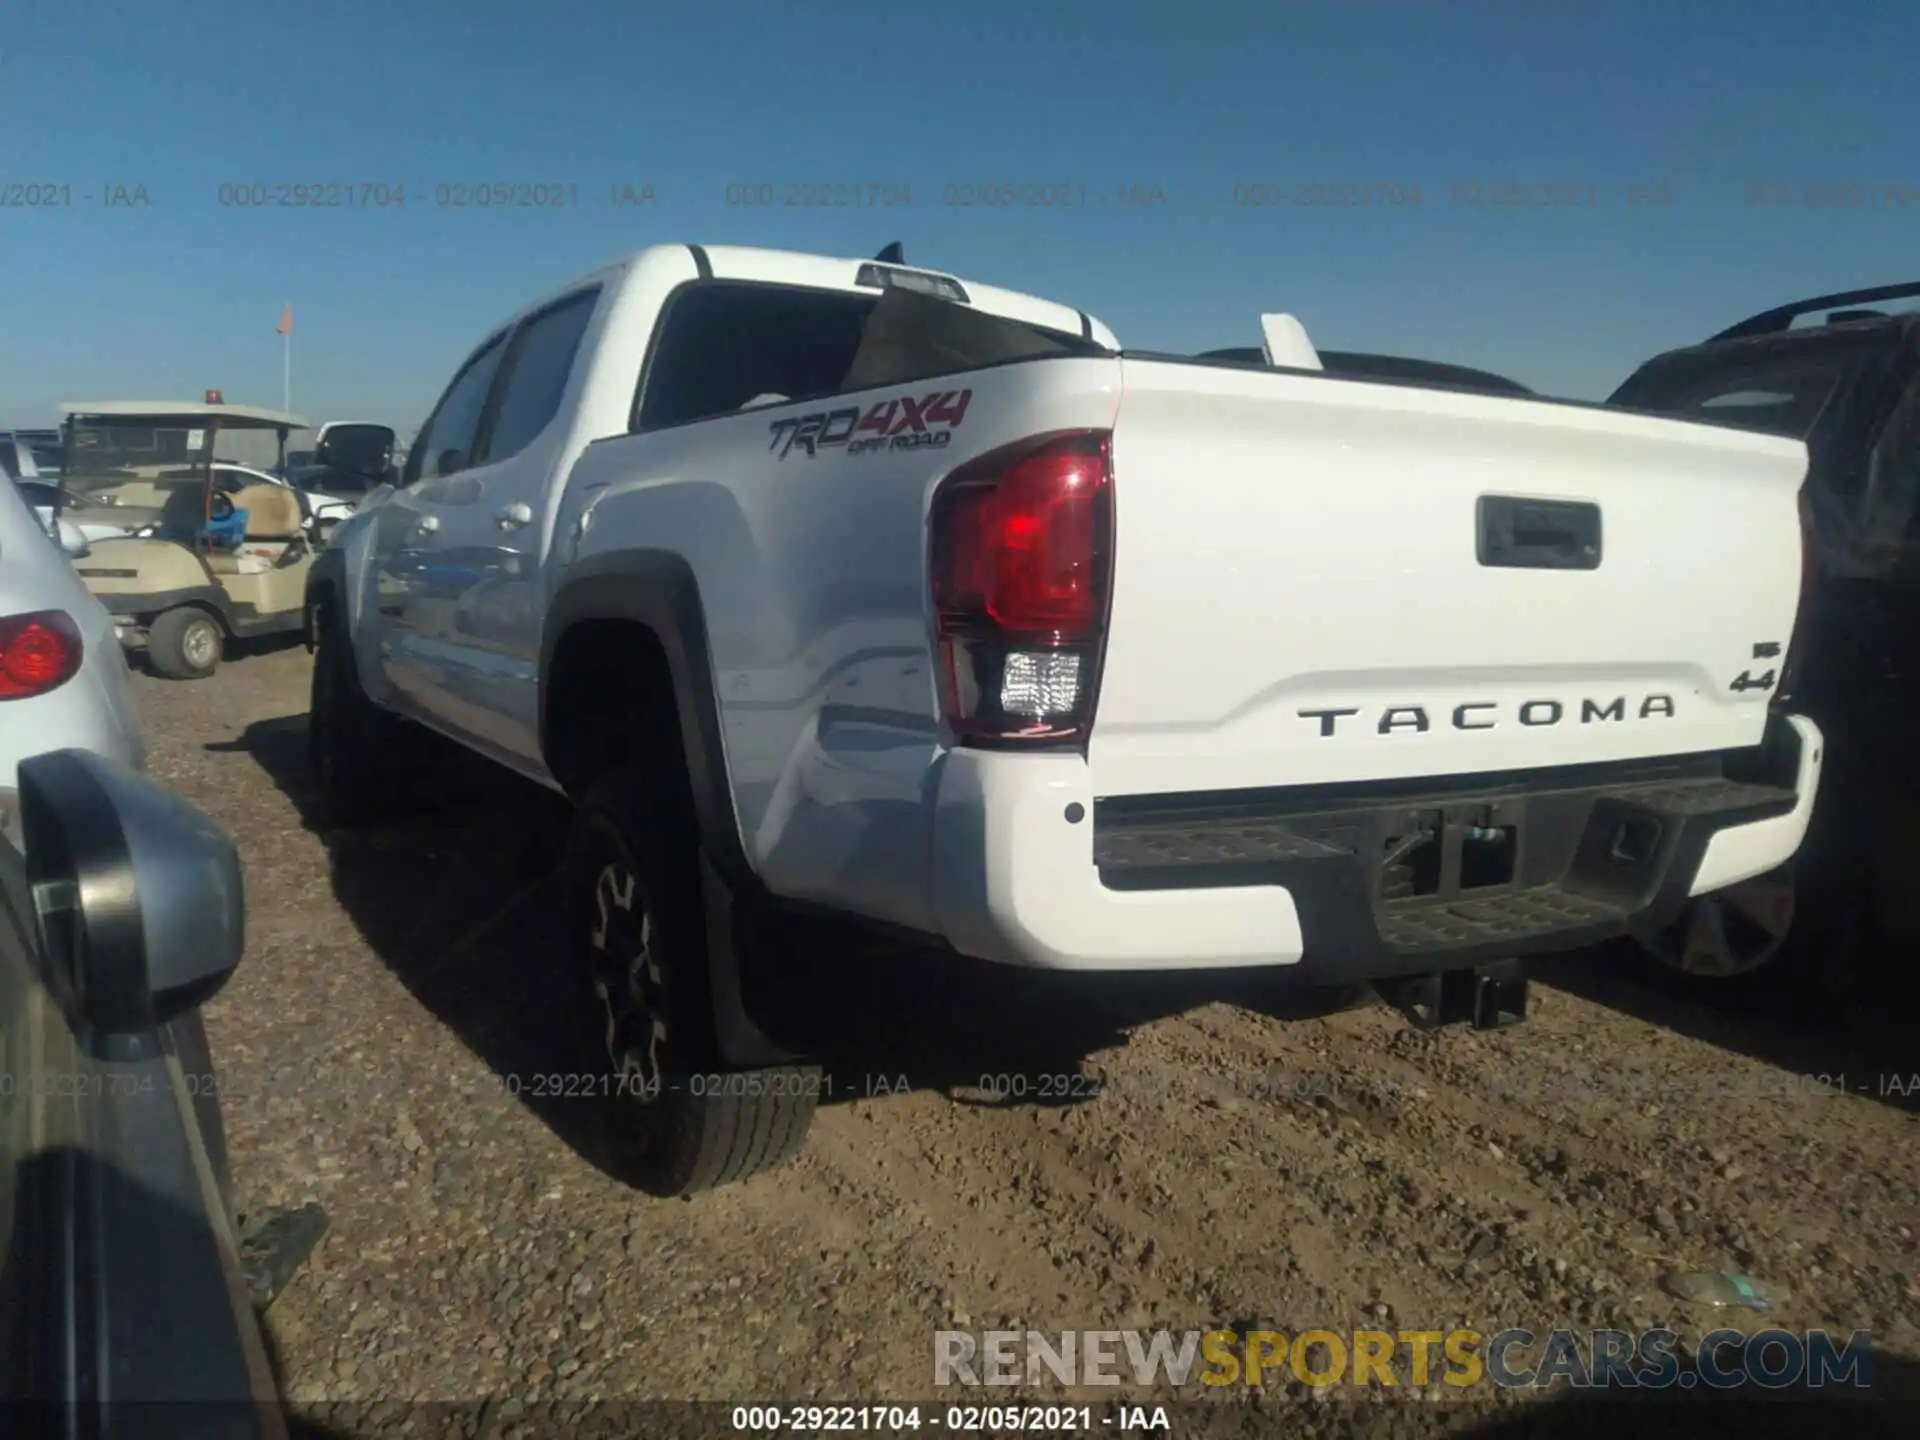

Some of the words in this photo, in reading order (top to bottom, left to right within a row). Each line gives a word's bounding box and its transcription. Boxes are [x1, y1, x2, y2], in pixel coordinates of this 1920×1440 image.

[769, 406, 859, 461] TRD
[889, 431, 951, 453] ROAD
[1297, 695, 1675, 737] TACOMA
